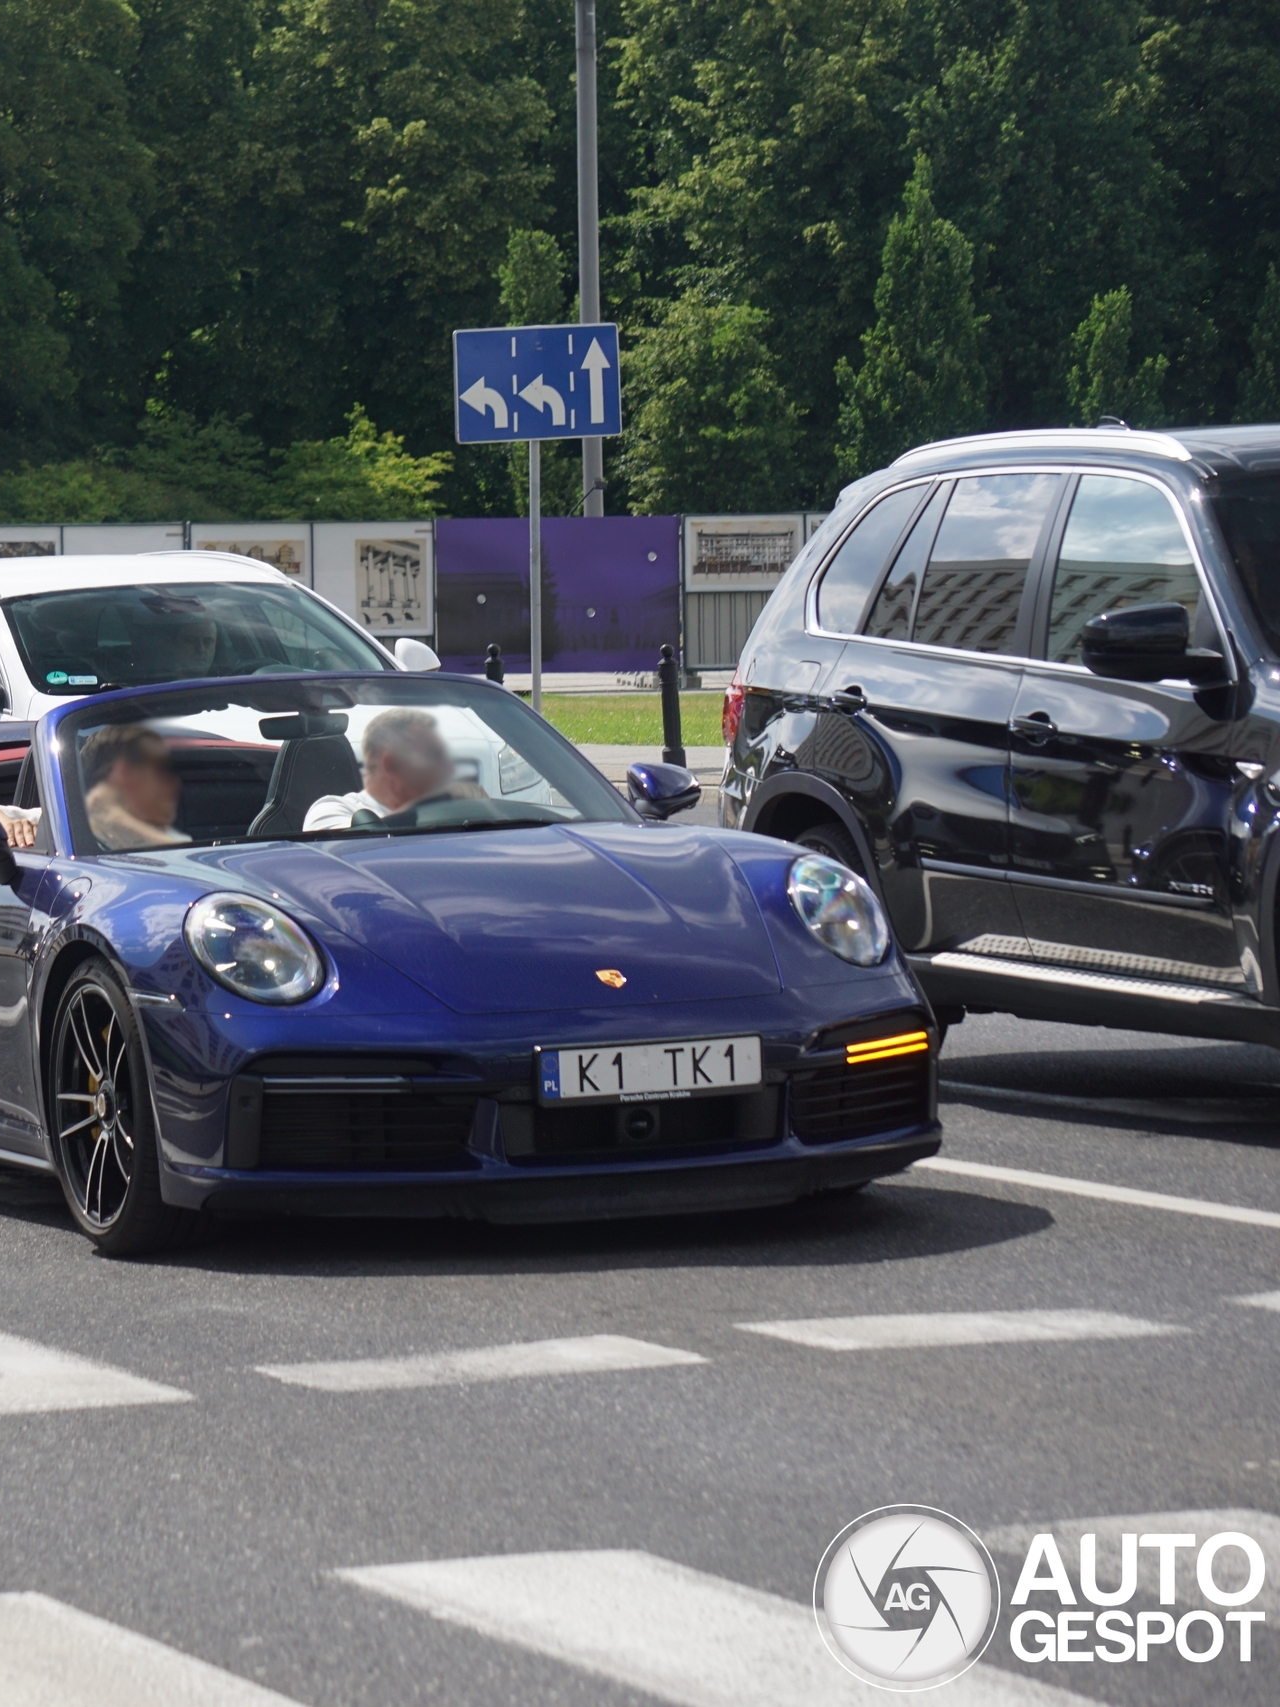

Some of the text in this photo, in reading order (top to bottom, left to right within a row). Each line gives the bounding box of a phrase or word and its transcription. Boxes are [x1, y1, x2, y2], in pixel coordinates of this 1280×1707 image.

[578, 1043, 735, 1093] K1 TK1
[544, 1080, 559, 1092] PL
